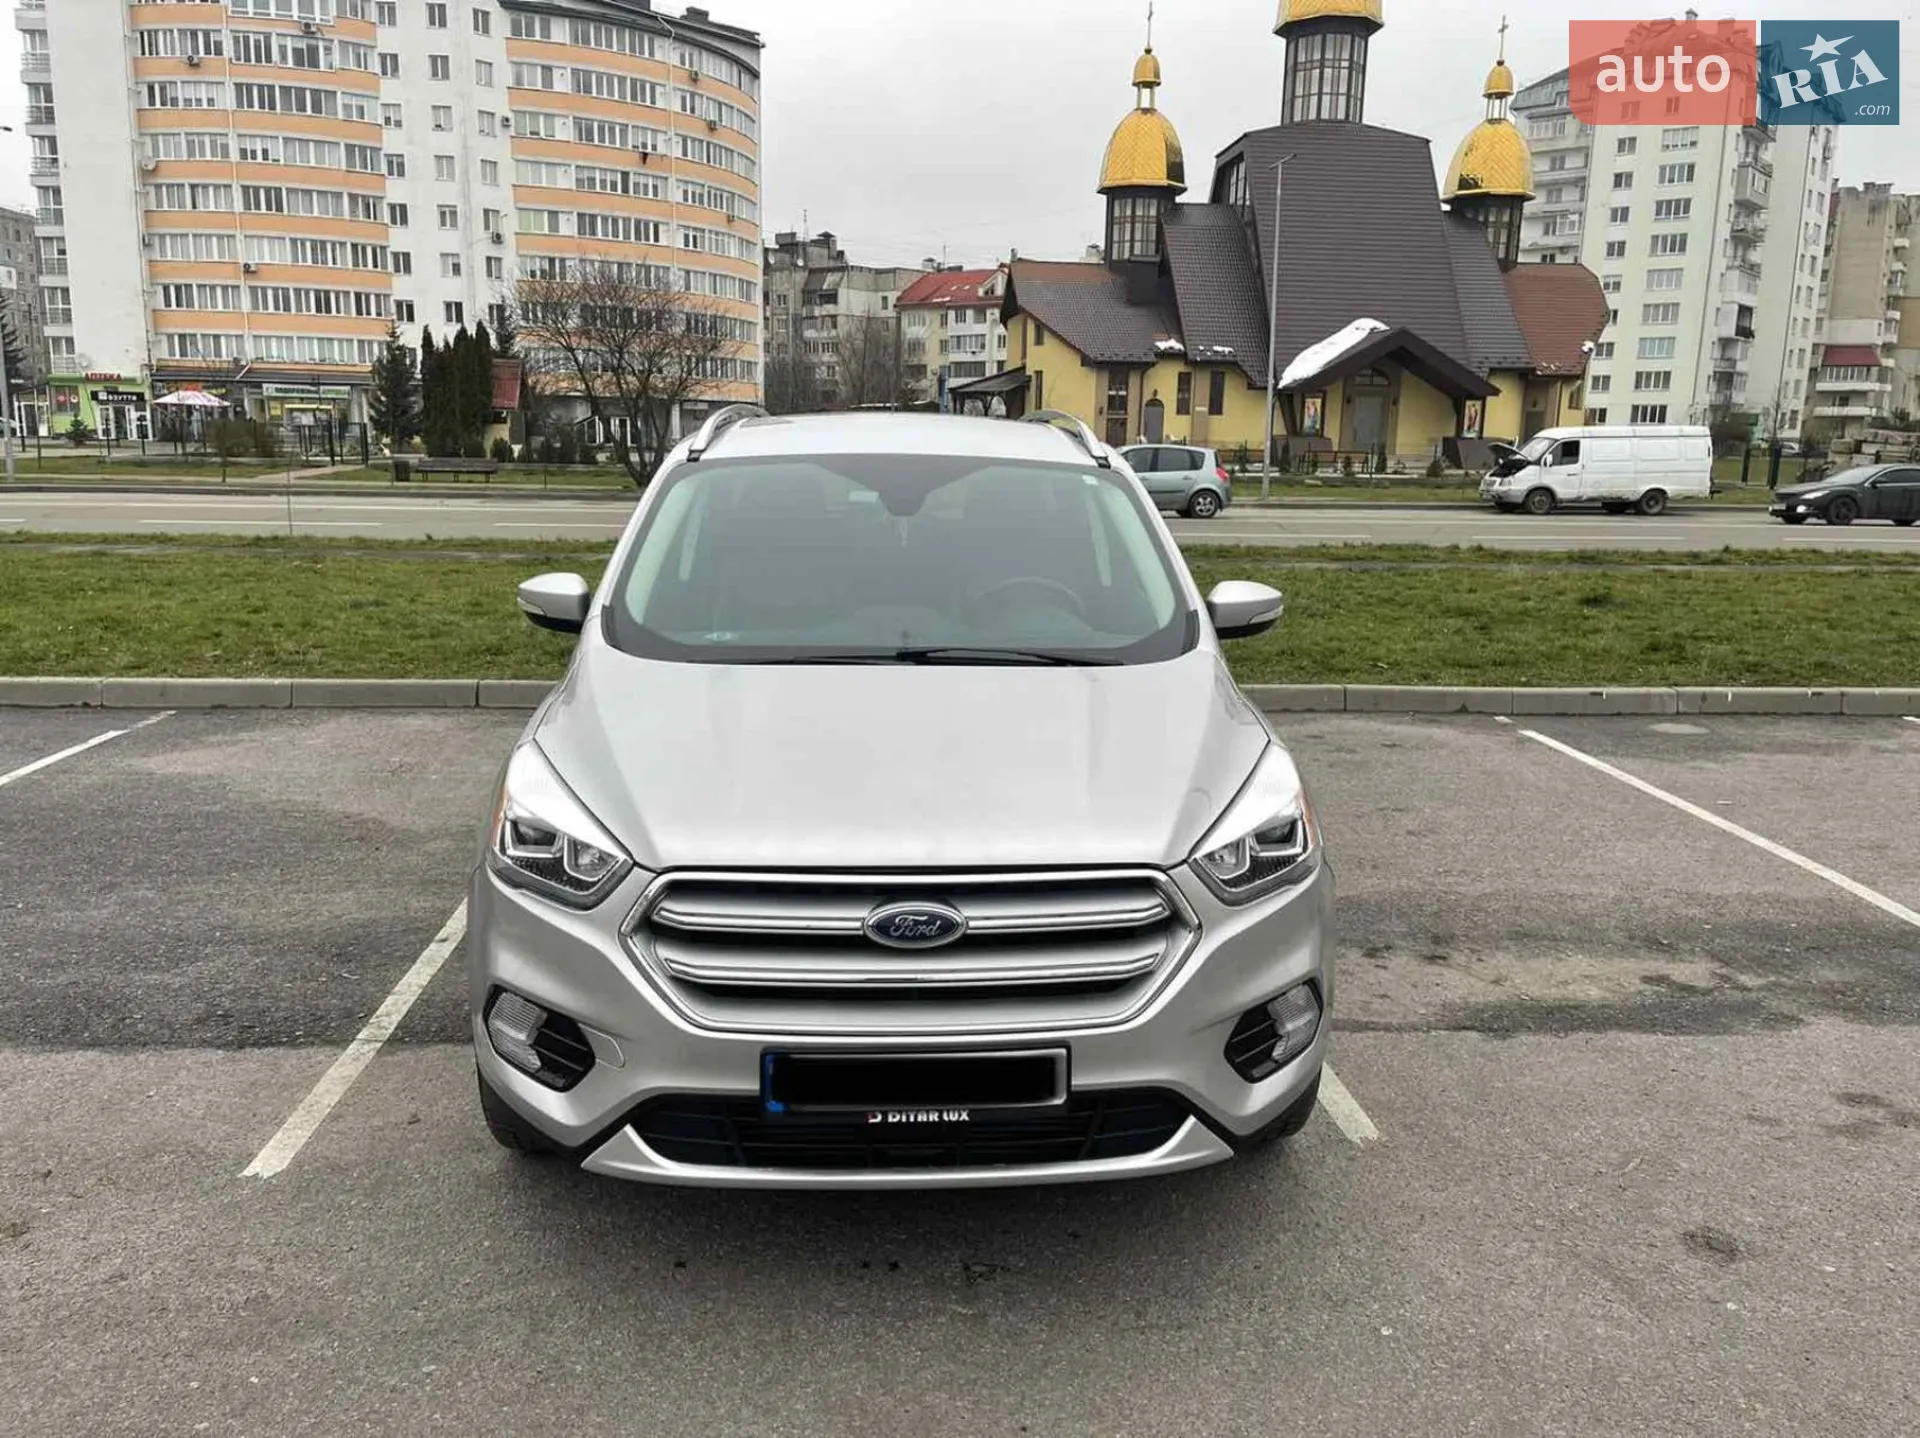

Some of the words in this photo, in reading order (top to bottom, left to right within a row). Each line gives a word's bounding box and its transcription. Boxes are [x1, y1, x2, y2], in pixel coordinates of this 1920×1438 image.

[889, 914, 941, 937] Ford
[887, 1109, 939, 1122] DITAR
[943, 1109, 970, 1121] LUX
